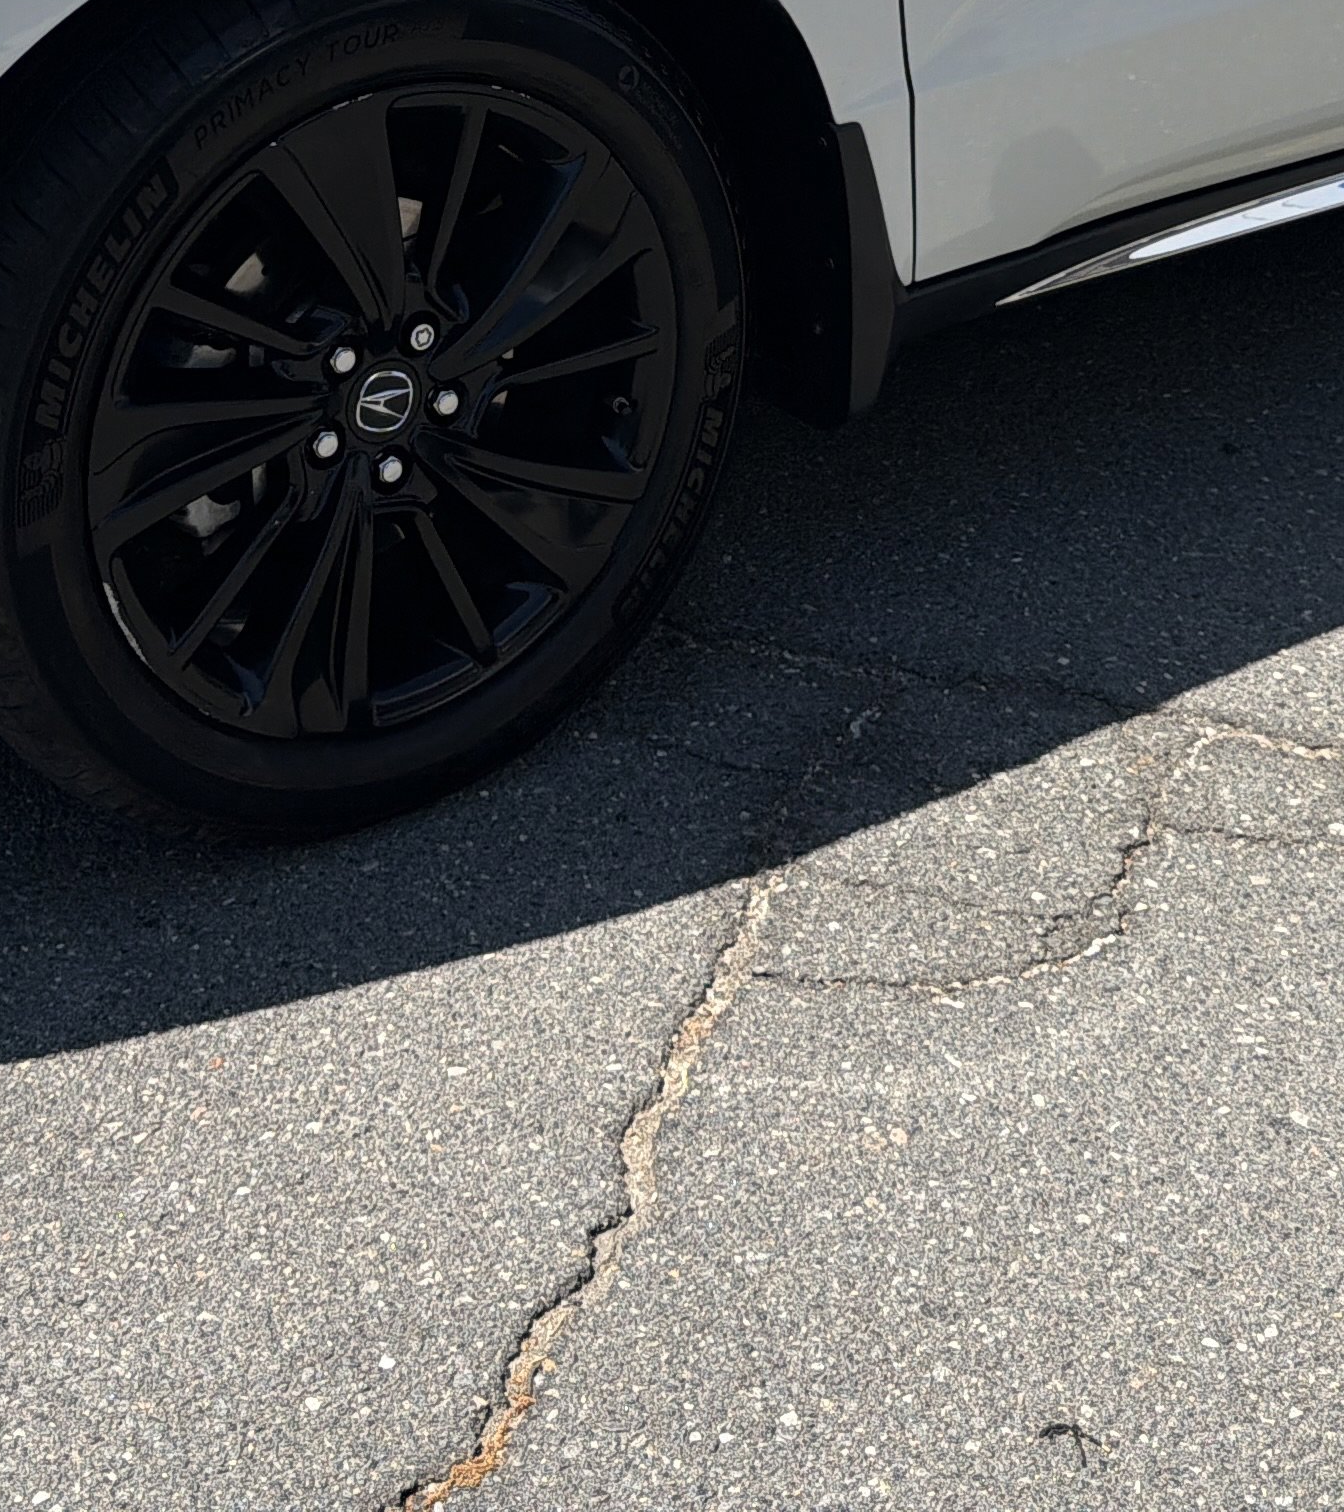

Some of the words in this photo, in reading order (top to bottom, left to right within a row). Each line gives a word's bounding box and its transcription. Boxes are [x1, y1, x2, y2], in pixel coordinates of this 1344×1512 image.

[193, 51, 312, 150] PRIMACY
[326, 23, 400, 62] TOUR
[35, 171, 173, 431] MICHELIN
